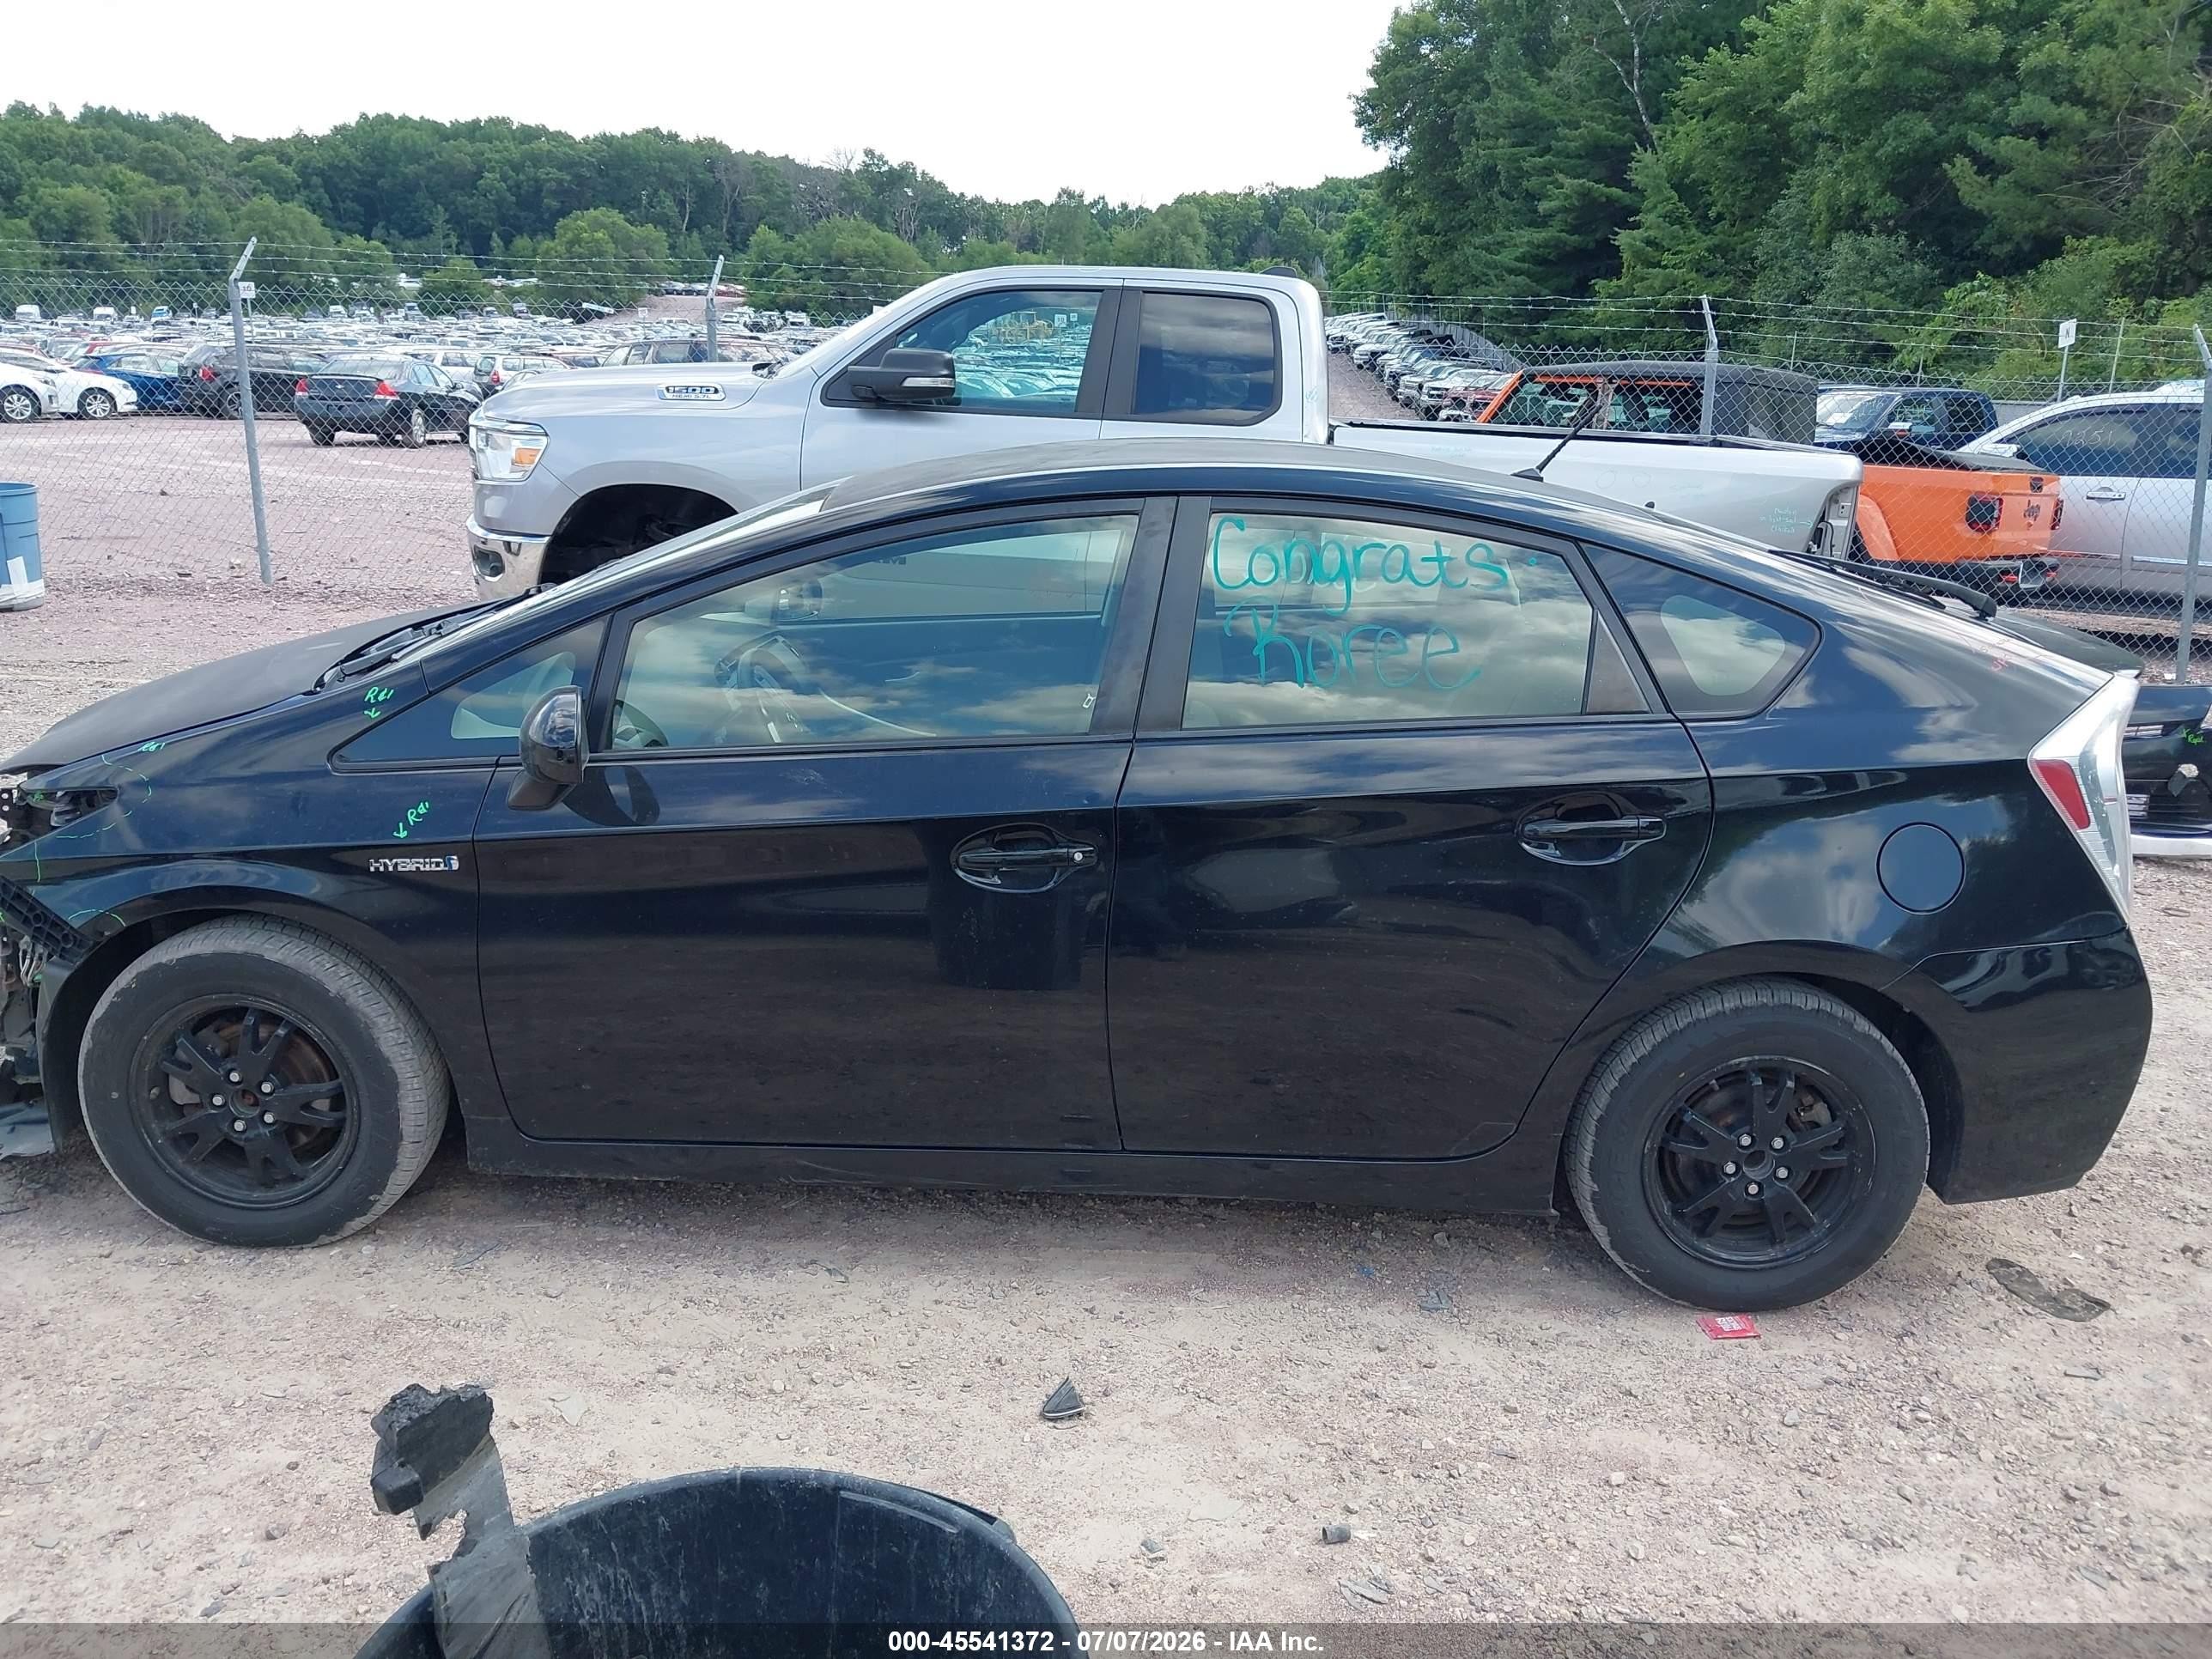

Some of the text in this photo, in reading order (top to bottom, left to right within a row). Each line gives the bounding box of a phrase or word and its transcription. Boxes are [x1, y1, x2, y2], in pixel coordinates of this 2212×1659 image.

[2064, 326, 2071, 340] N
[1212, 516, 1509, 616] Congrats
[368, 858, 445, 872] HYBRID
